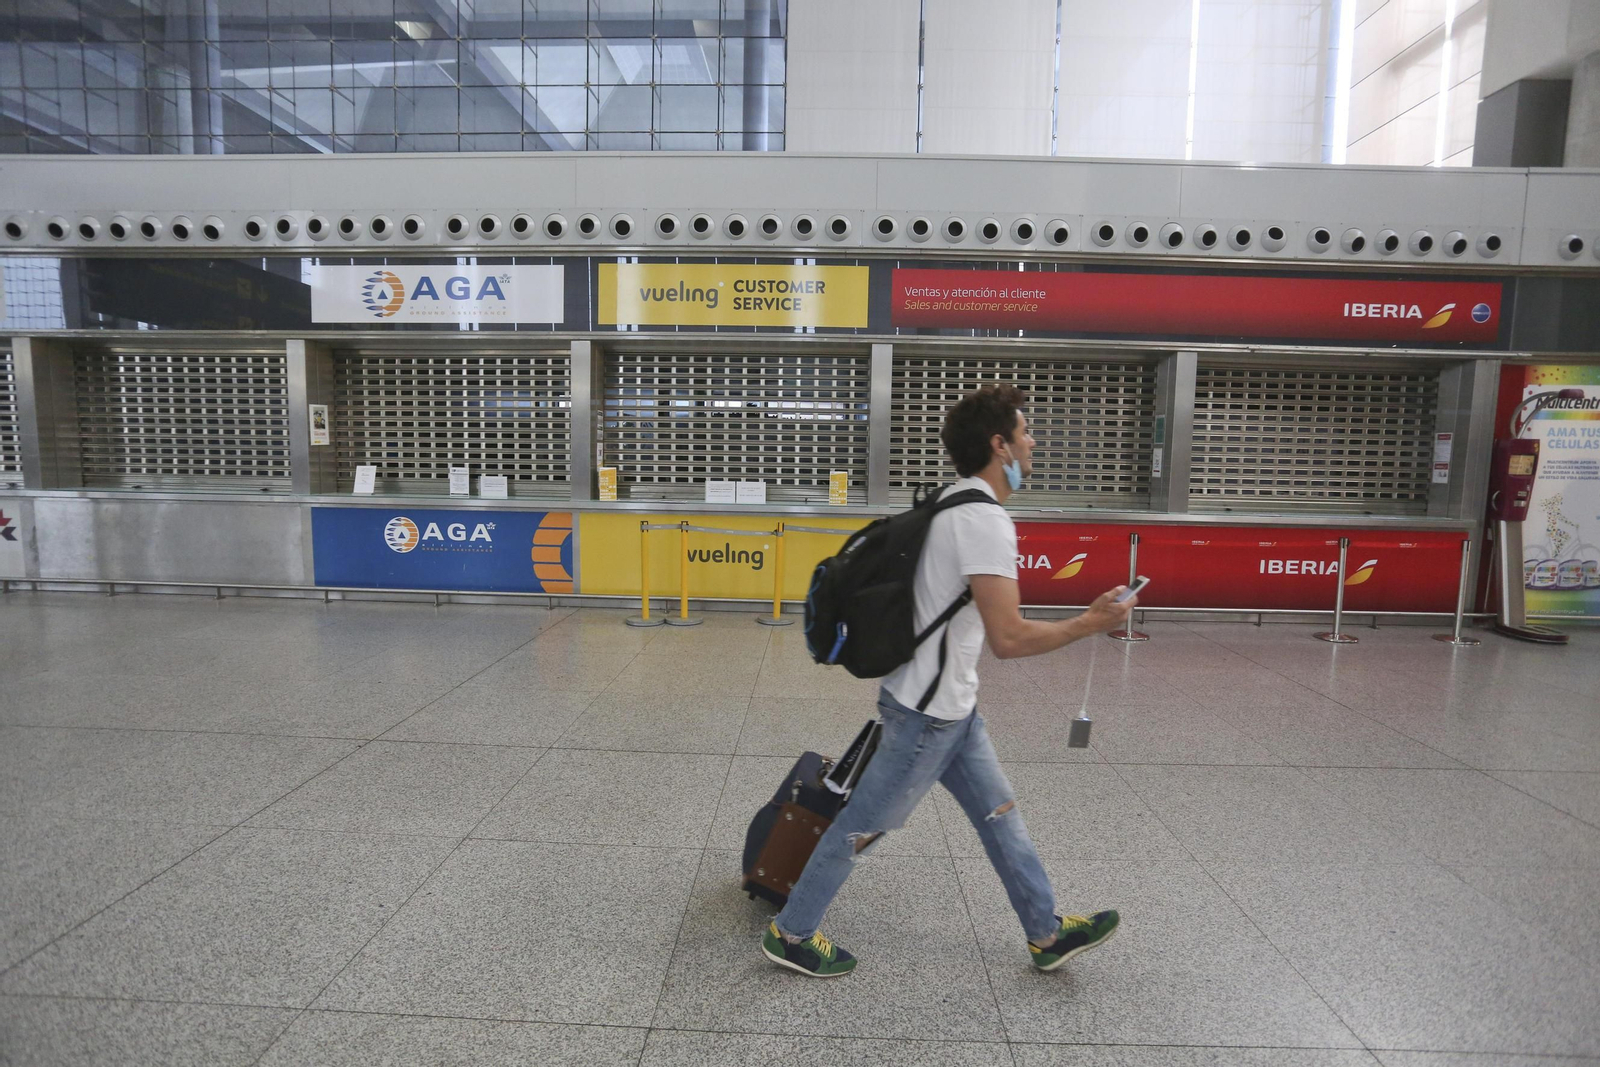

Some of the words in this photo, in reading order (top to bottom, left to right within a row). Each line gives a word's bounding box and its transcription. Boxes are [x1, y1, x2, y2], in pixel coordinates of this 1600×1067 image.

[410, 276, 506, 301] AGA
[639, 280, 719, 309] vueling
[733, 279, 826, 294] CUSTOMER
[904, 286, 941, 297] Ventas
[942, 289, 950, 300] y
[951, 287, 997, 299] atención
[999, 288, 1009, 299] al
[1010, 288, 1047, 299] cliente
[733, 297, 802, 311] SERVICE
[904, 299, 931, 310] Sales
[932, 300, 952, 311] and
[950, 302, 1001, 312] customer
[1003, 302, 1039, 313] service
[1343, 302, 1423, 319] IBERIA
[1547, 427, 1578, 438] AMA
[422, 522, 492, 542] AGA
[687, 542, 764, 571] vueling
[1259, 559, 1339, 575] IBERIA
